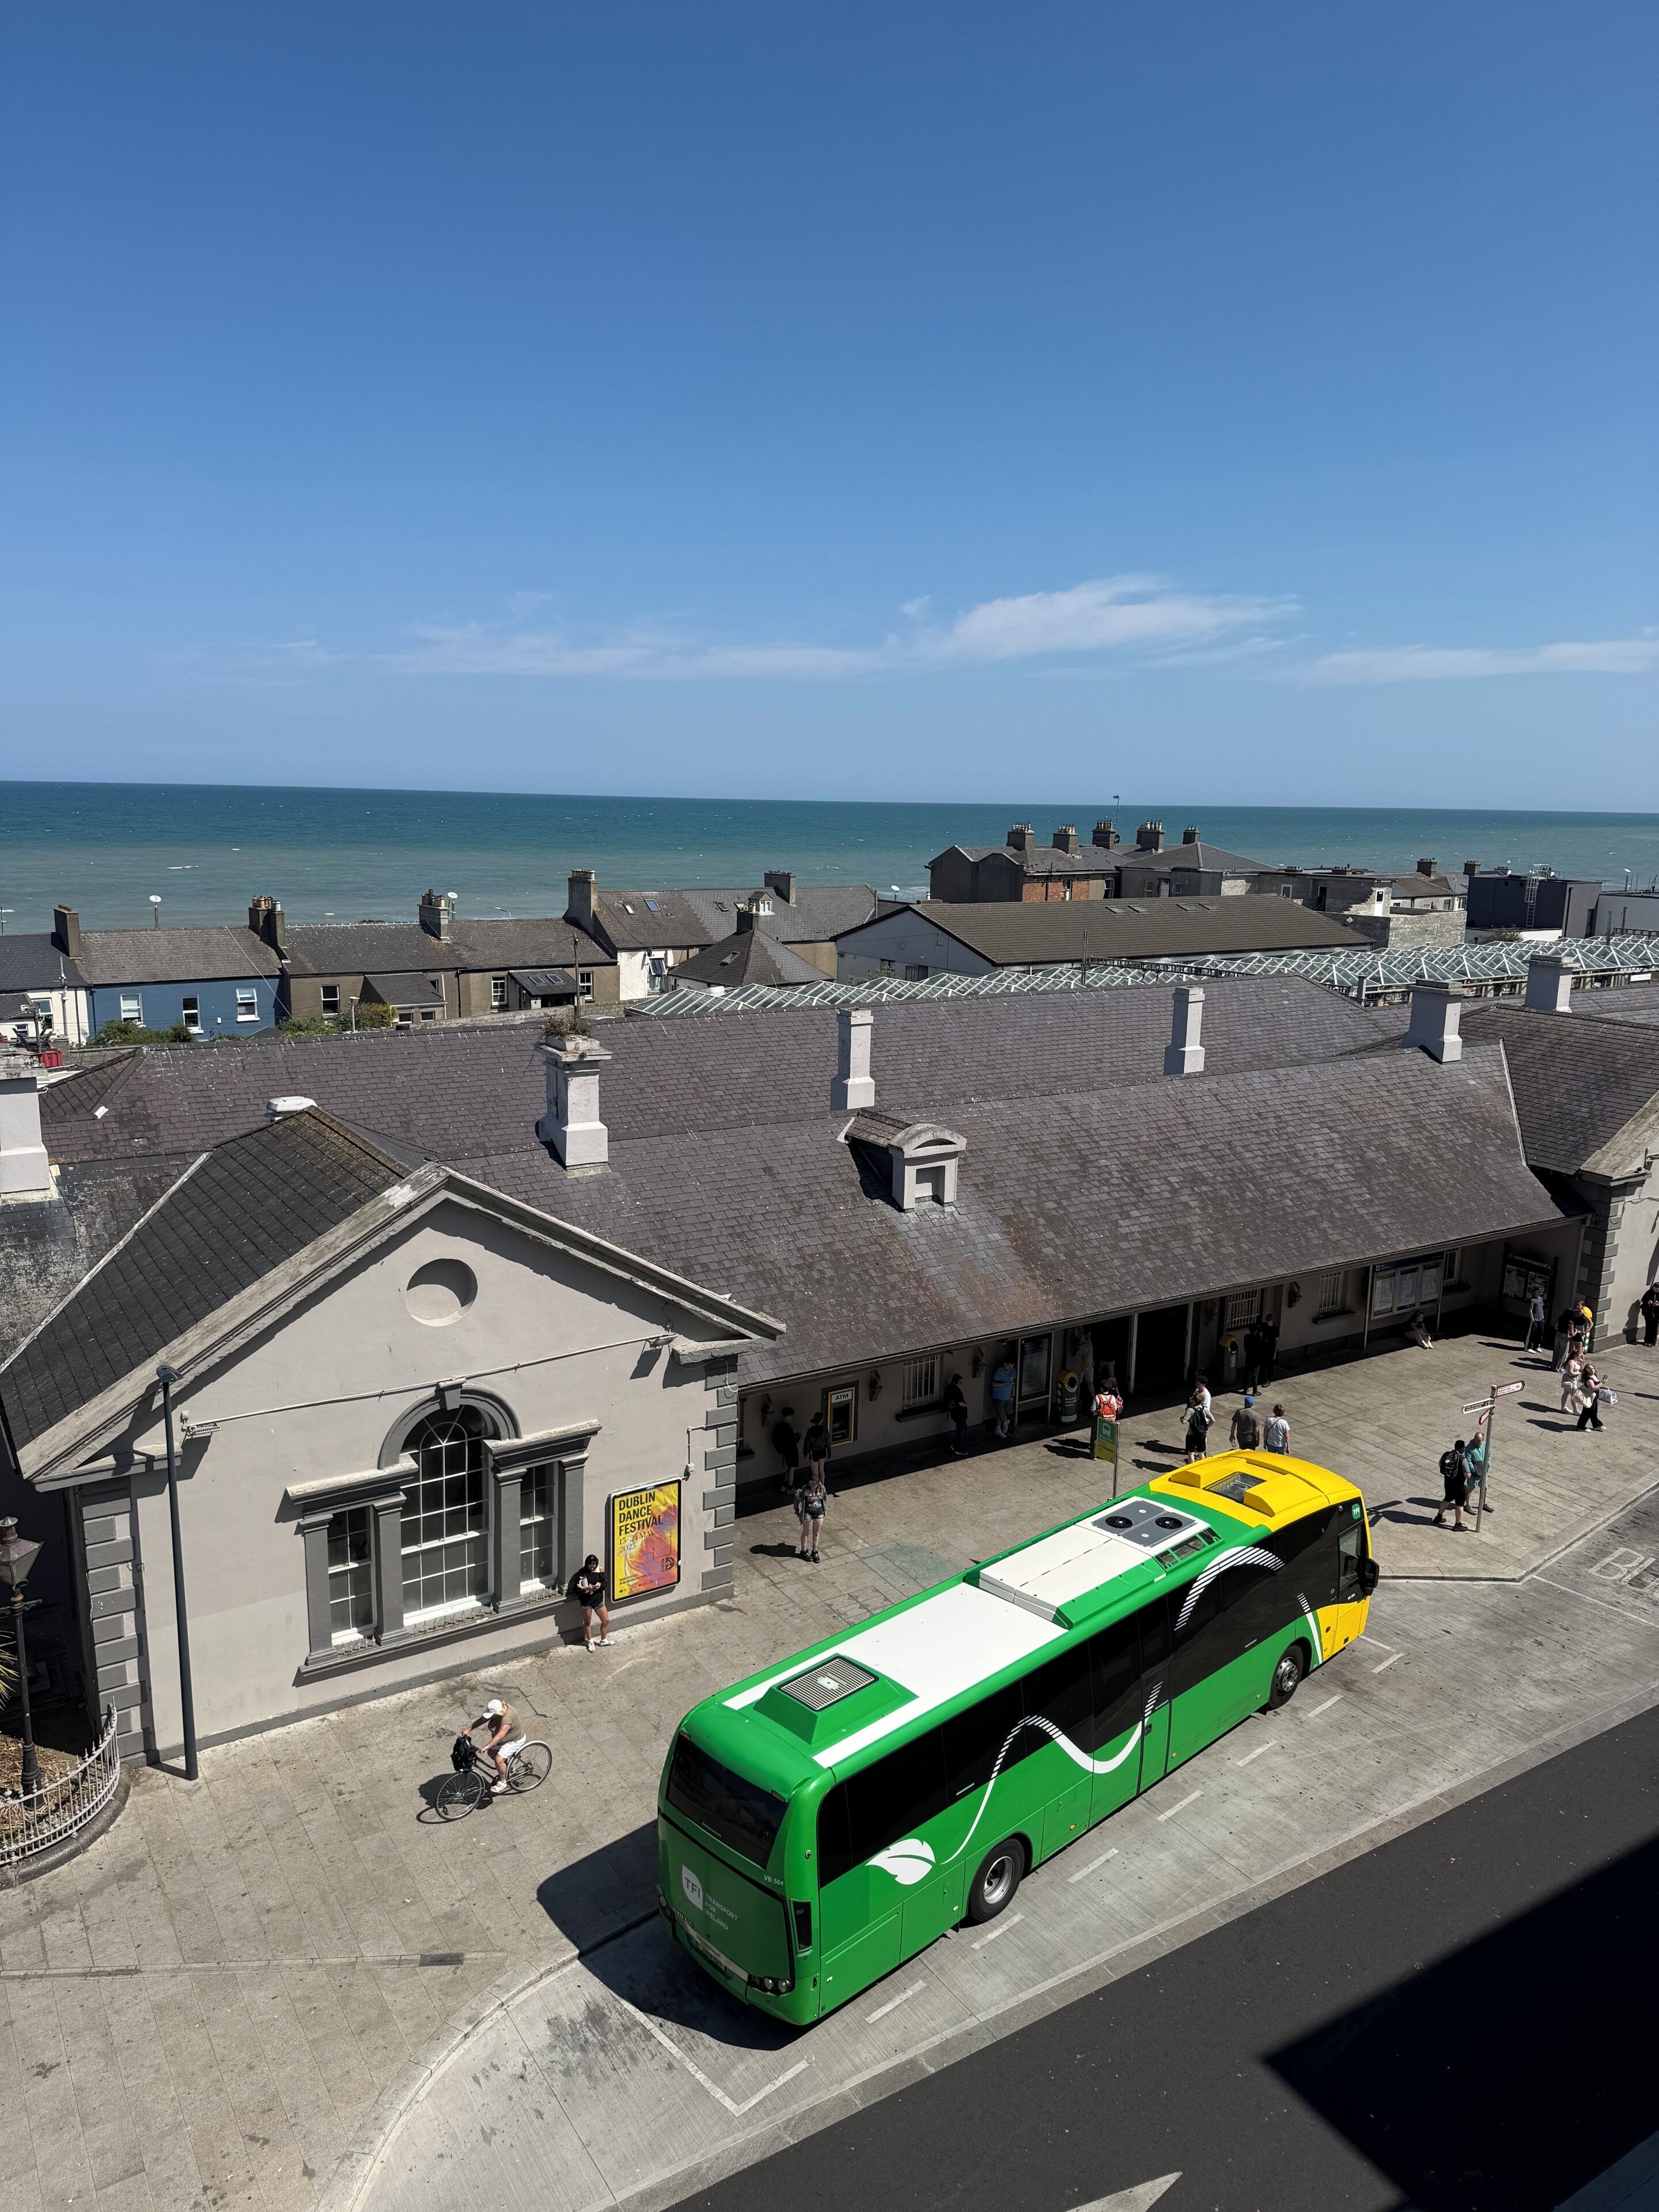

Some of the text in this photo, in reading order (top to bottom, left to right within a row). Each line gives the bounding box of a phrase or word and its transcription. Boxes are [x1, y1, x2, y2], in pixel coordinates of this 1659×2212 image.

[619, 1491, 656, 1511] DUBLIN
[619, 1505, 652, 1524] DANCE
[619, 1514, 664, 1536] FESTIVAL
[619, 1542, 637, 1554] 2025
[1587, 1547, 1659, 1599] BU
[684, 1876, 701, 1899] TFI
[764, 1874, 784, 1887] VB 504
[705, 1893, 738, 1921] TRANSPORT
[705, 1902, 717, 1914] FOR
[672, 1907, 694, 1928] VOLVO
[705, 1910, 728, 1930] IRELAND
